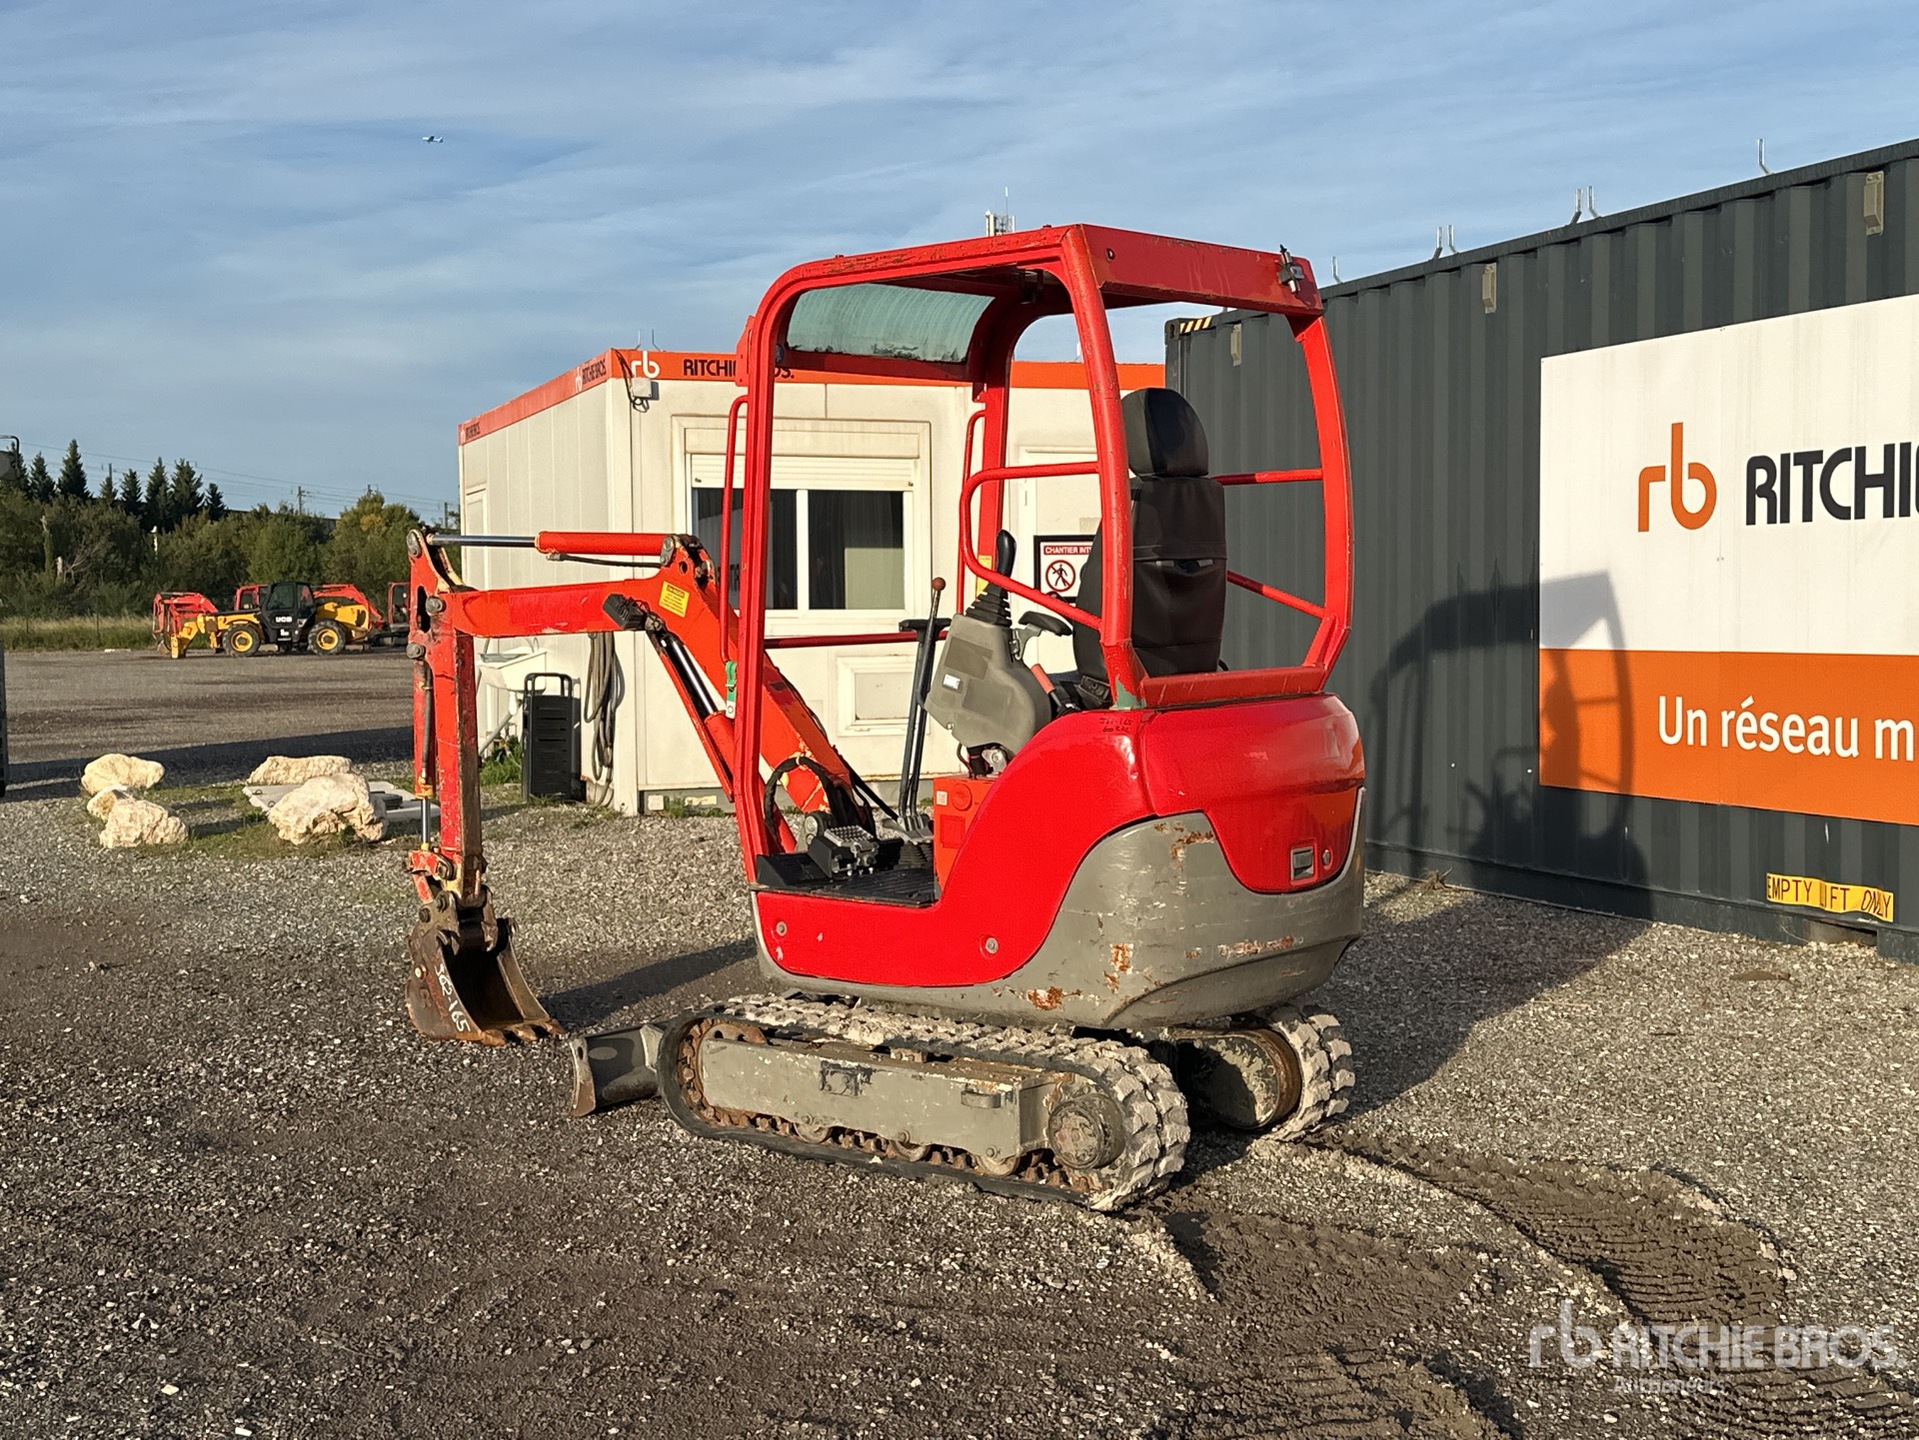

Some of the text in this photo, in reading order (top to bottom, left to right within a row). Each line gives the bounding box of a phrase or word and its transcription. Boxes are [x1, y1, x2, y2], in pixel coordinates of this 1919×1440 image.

[683, 359, 737, 378] RITCHI
[1638, 422, 1919, 532] rb RITCHI
[1045, 546, 1078, 554] CHANTIER
[1658, 695, 1707, 747] Un
[1721, 694, 1860, 759] réseau
[1767, 875, 1892, 918] EMPTY LIFT ONLY
